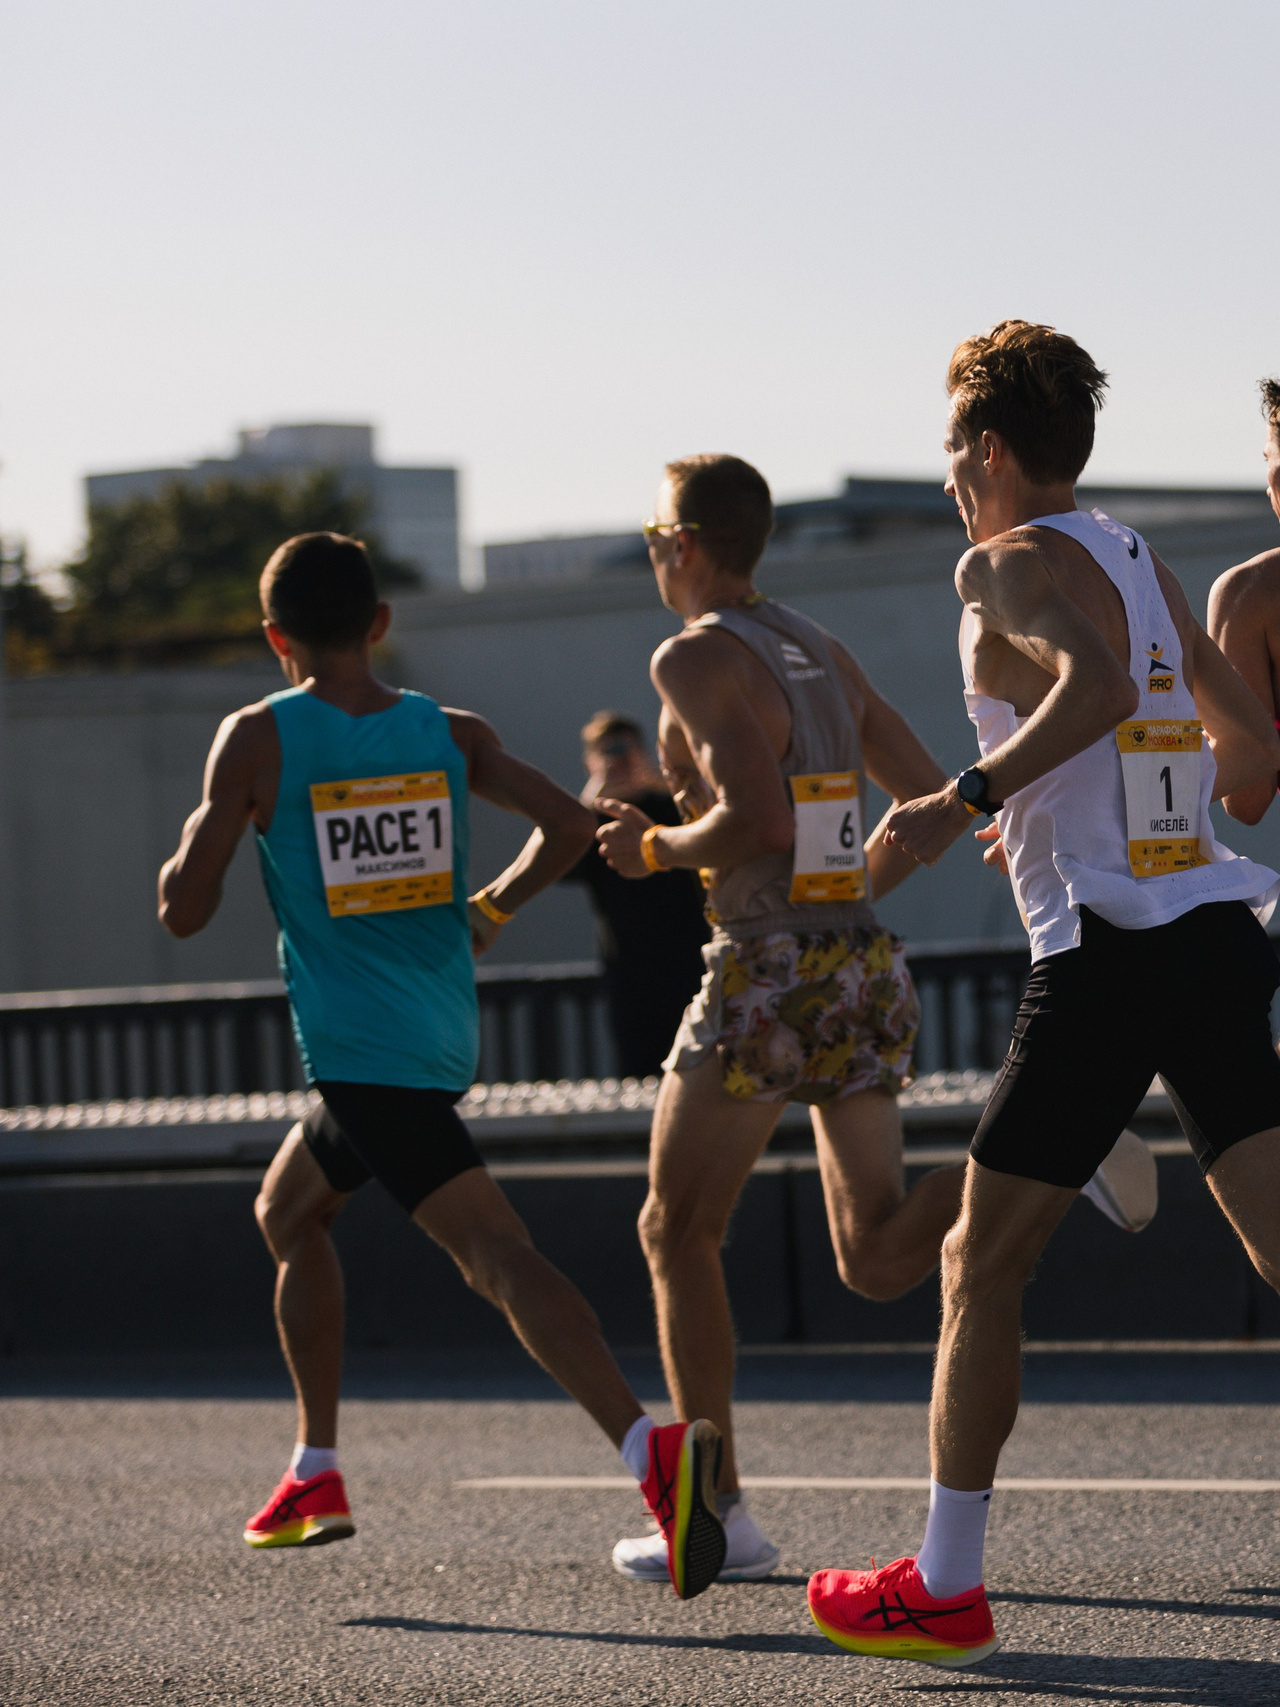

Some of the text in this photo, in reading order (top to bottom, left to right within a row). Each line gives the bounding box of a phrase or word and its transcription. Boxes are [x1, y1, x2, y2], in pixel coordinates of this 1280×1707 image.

[1149, 677, 1173, 691] PRO
[1159, 766, 1173, 812] 1
[326, 806, 442, 861] PACE 1
[839, 810, 855, 850] 6
[355, 857, 426, 875] МАКСИМОВ
